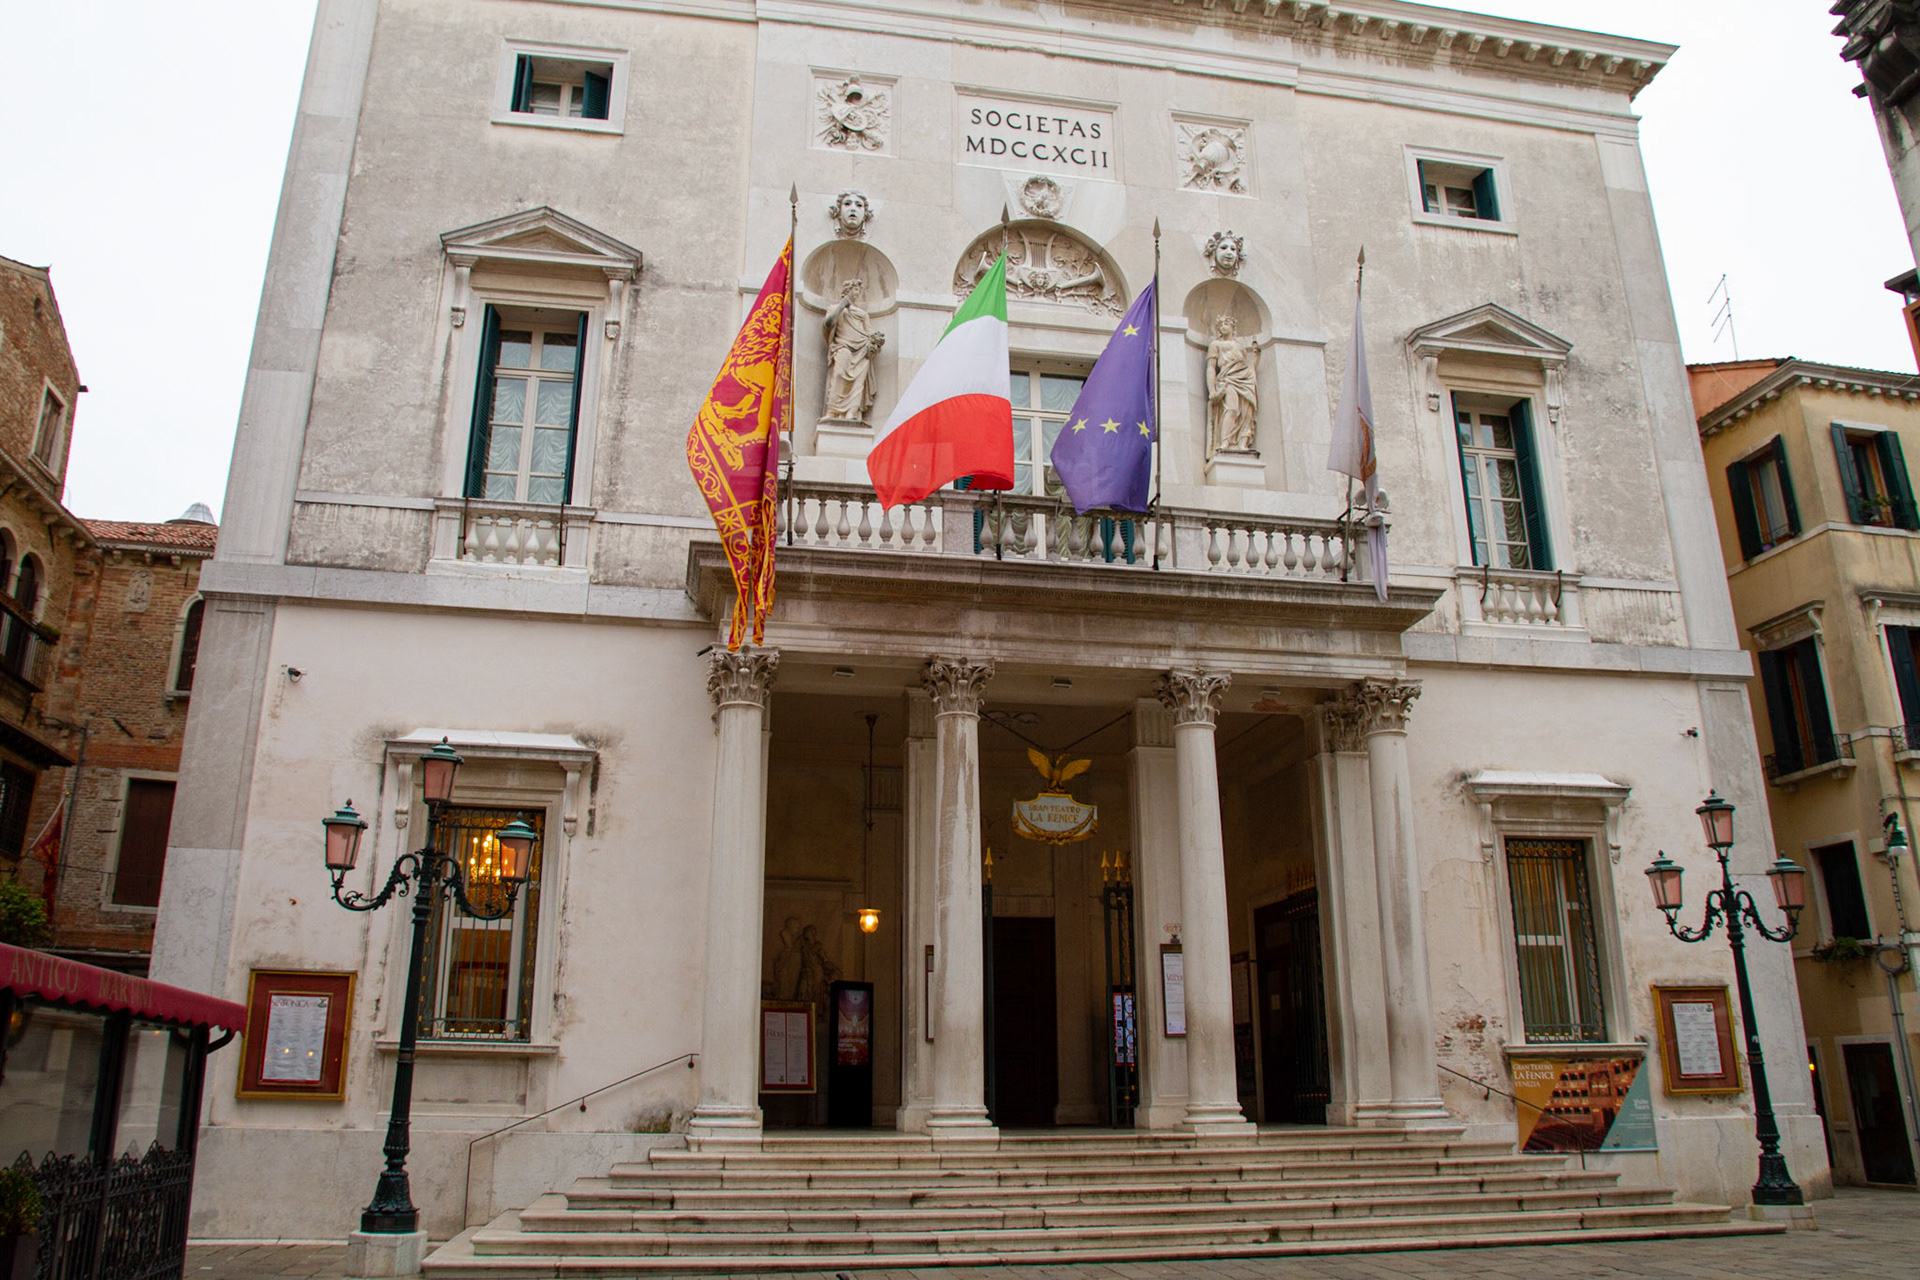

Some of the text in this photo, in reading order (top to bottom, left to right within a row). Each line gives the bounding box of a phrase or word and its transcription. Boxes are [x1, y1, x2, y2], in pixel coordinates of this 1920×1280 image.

[971, 108, 1101, 139] SOCIETAS
[966, 135, 1108, 168] MDCCXCII
[1028, 804, 1080, 814] GRAN TEATRO
[1029, 813, 1079, 824] LA FENICE
[8, 949, 153, 1009] ANTICO MARTINI
[1513, 1071, 1555, 1080] LA FENICE
